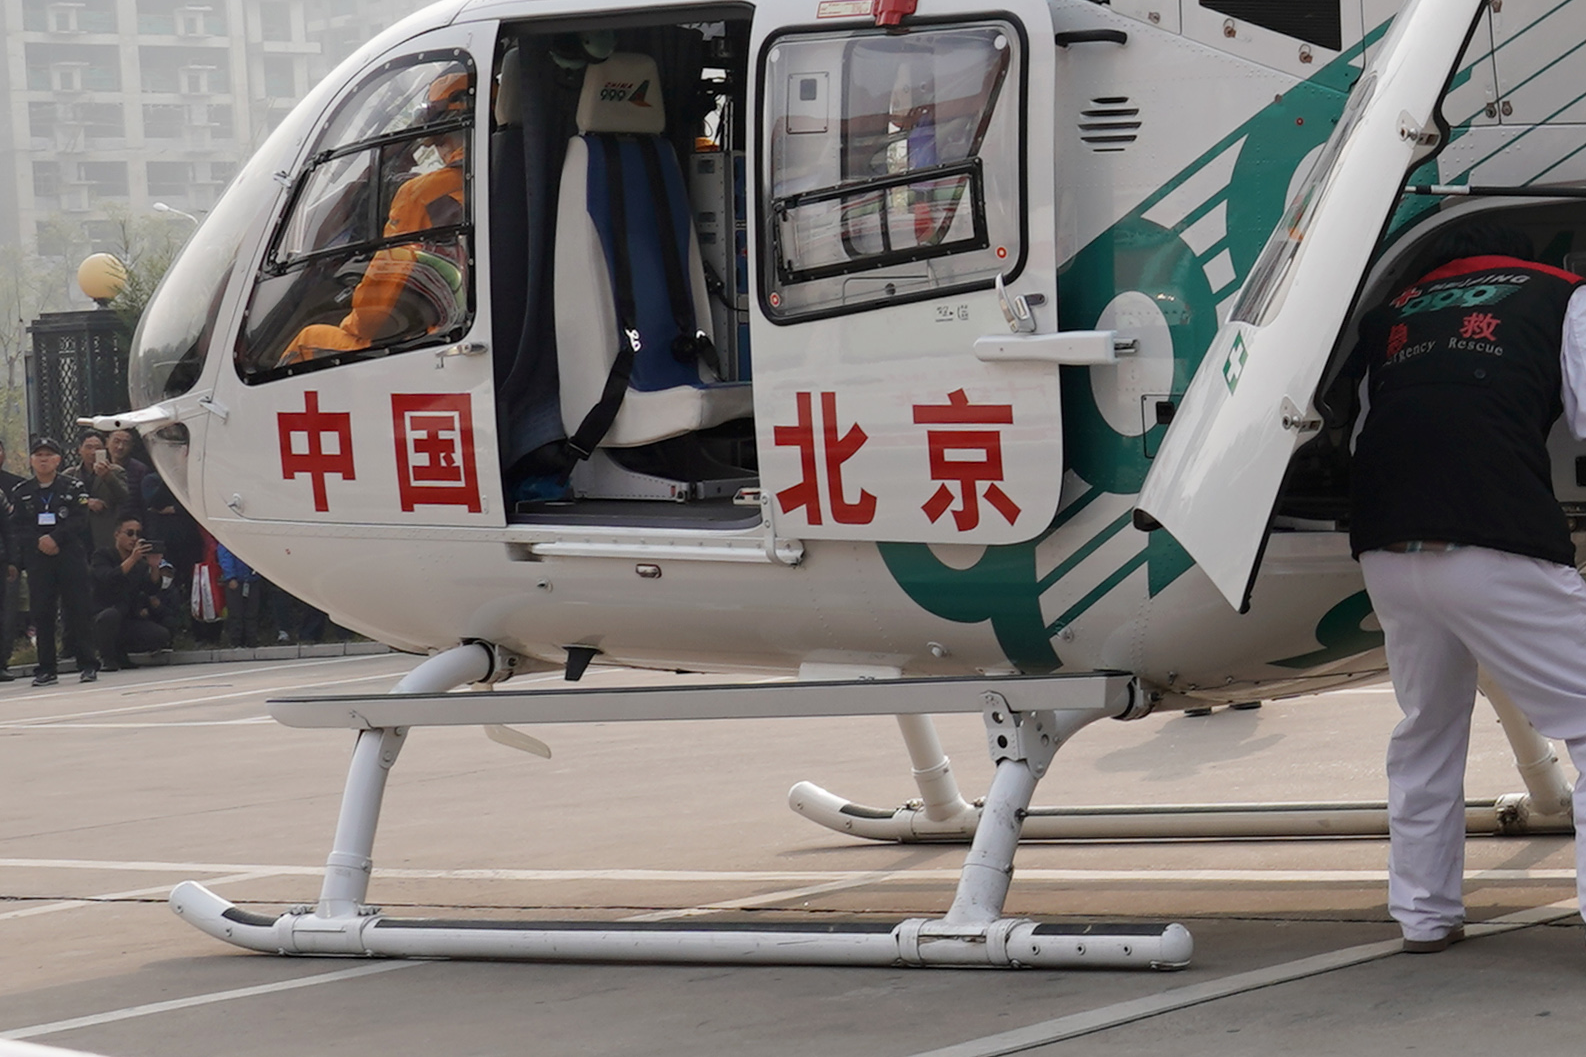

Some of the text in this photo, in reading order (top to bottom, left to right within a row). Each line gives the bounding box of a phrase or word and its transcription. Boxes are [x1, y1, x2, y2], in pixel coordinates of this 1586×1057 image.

[600, 89, 626, 101] 999
[1448, 337, 1504, 356] Rescue
[277, 389, 1021, 531] 中国 北京
